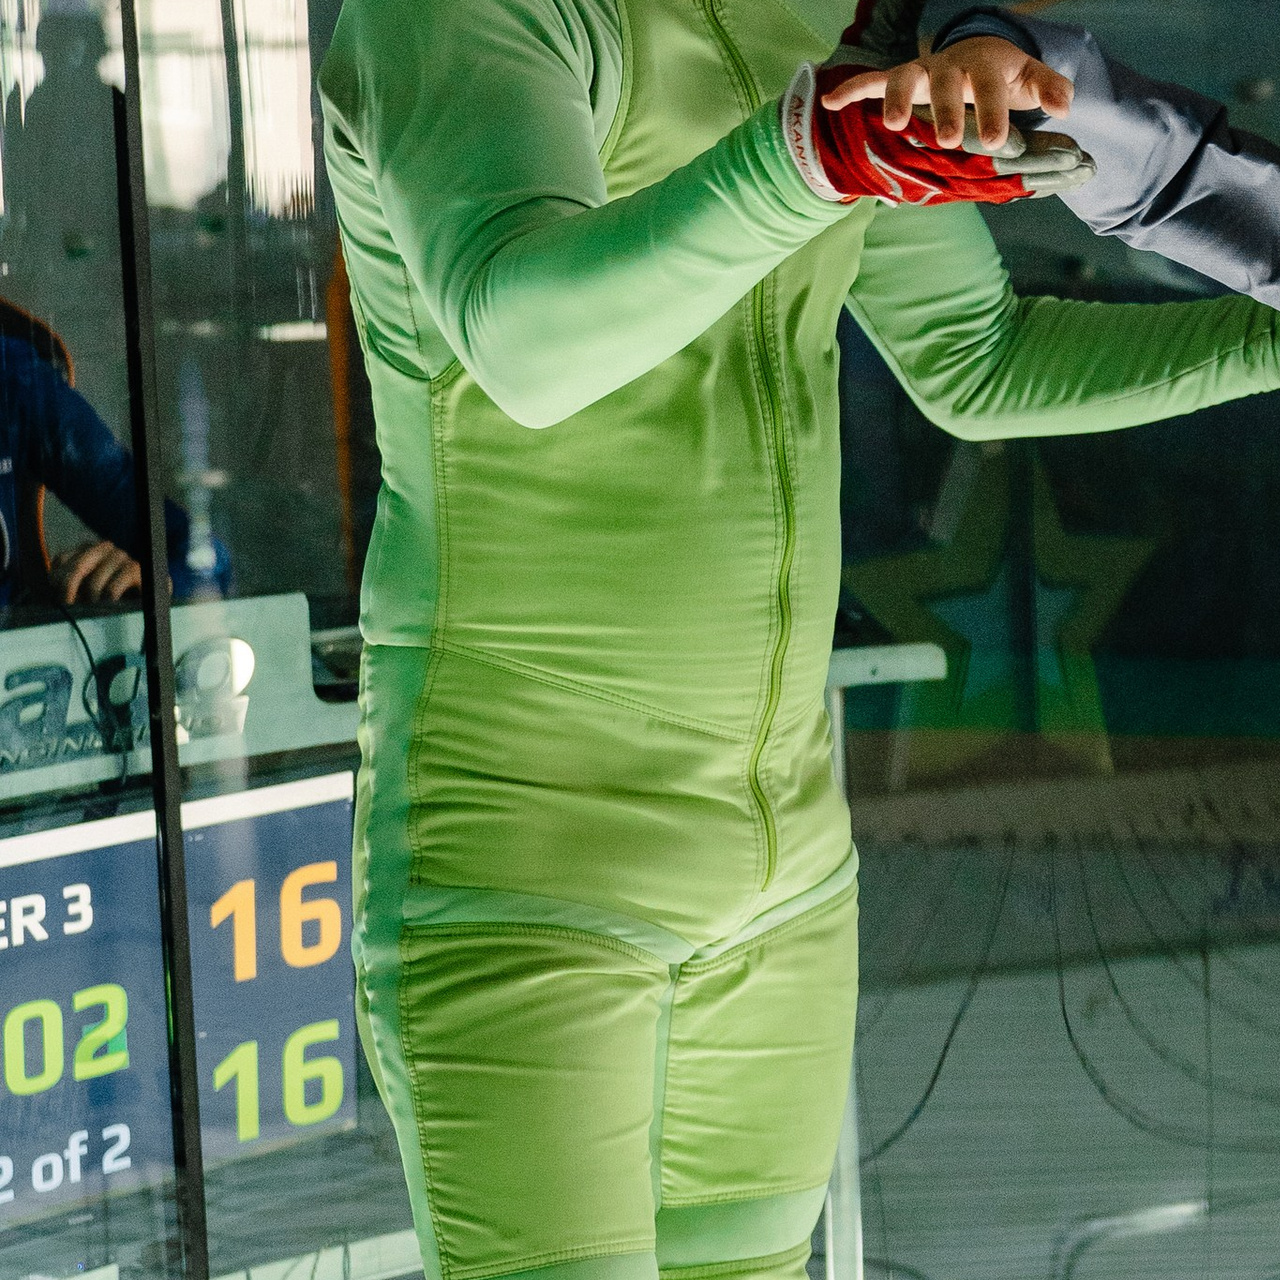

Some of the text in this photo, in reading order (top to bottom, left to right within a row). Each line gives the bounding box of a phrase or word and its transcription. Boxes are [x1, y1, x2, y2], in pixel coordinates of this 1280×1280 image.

[62, 882, 94, 936] 3
[210, 860, 343, 983] 16
[212, 1018, 345, 1144] 16
[31, 1128, 89, 1193] of
[101, 1122, 132, 1175] 2
